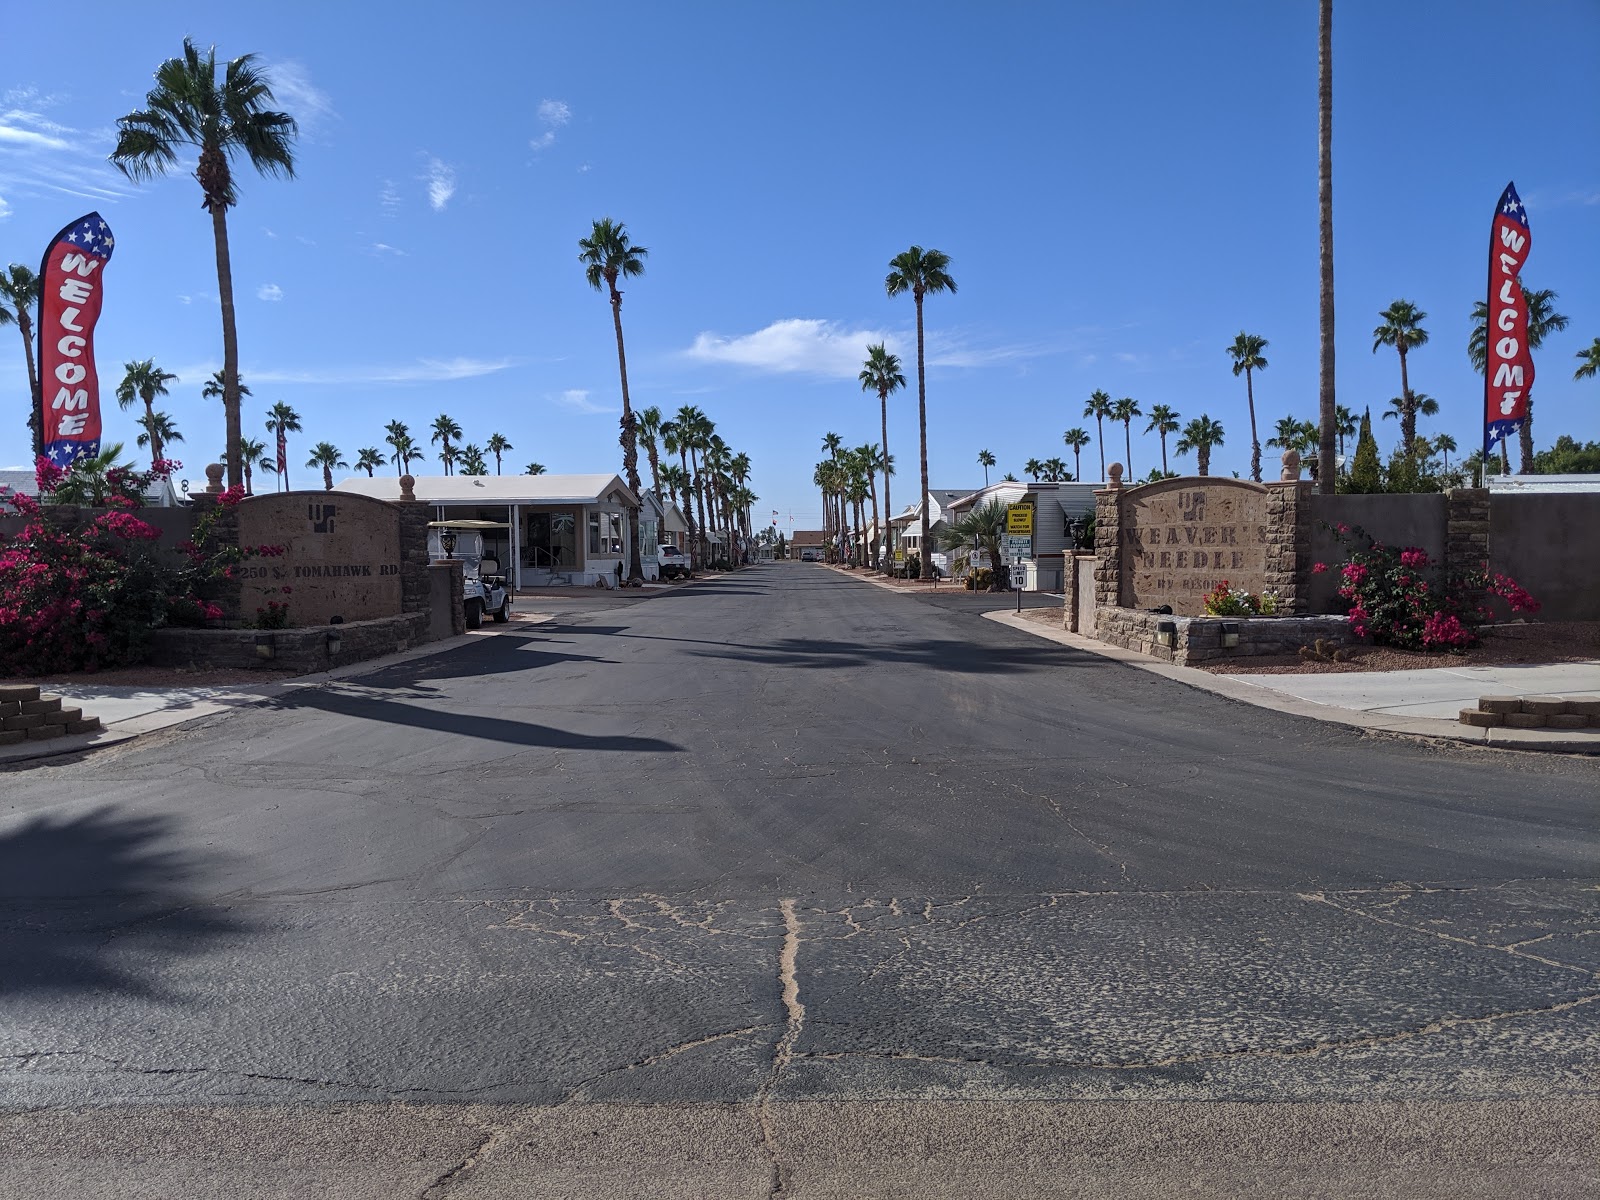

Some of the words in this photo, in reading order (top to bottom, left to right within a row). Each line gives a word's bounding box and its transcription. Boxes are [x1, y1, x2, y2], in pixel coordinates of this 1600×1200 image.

[51, 252, 100, 436] WELCOME
[1125, 525, 1267, 545] WEAVER'S
[1142, 550, 1245, 570] NEEDLE
[240, 566, 267, 579] 250
[294, 564, 372, 578] TOMAHAWK
[1015, 577, 1024, 585] 10
[1182, 578, 1223, 590] RESOR
